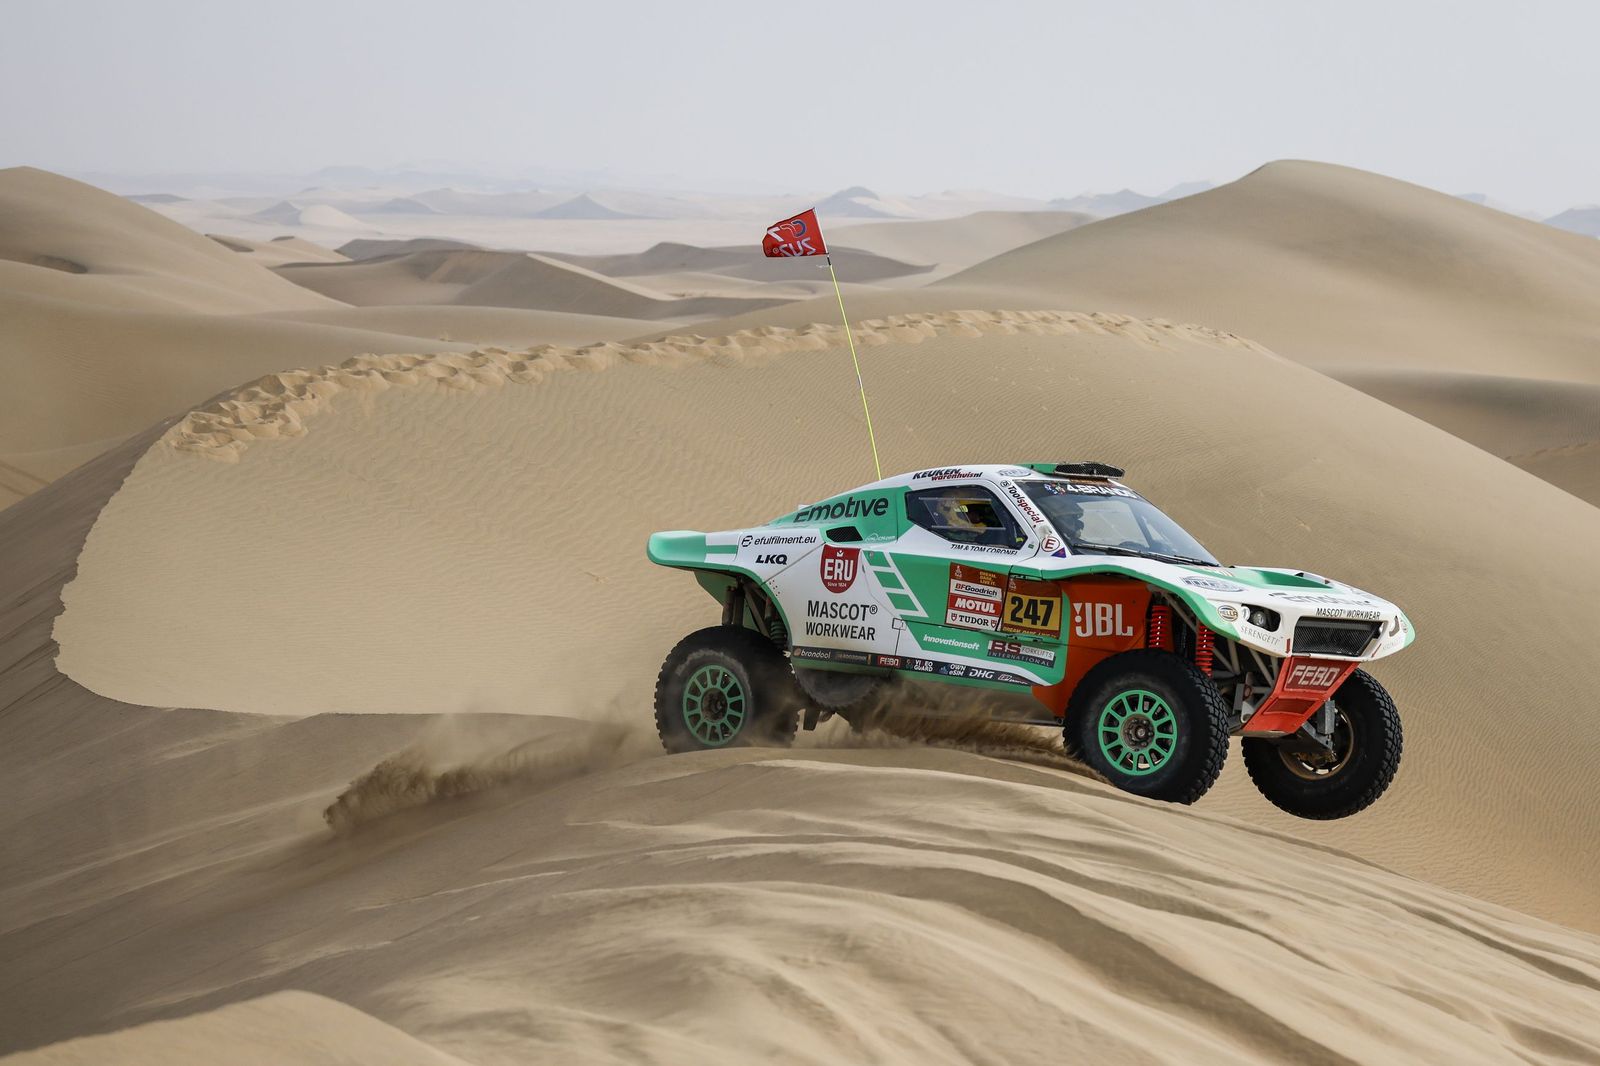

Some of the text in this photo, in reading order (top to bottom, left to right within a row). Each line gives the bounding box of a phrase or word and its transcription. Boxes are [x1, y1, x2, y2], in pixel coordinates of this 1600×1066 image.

[913, 468, 962, 480] KEUKEN
[793, 496, 889, 523] Emotive
[1008, 485, 1044, 524] Toolspecial
[754, 535, 817, 546] efulfilment.eu
[755, 553, 788, 565] LKQ
[824, 558, 854, 582] ERU
[955, 583, 998, 597] BFGoodrich
[955, 598, 996, 613] MOTUL
[1010, 596, 1054, 627] 247
[958, 614, 989, 627] TUDOR
[1073, 602, 1134, 638] JBL
[1346, 609, 1381, 620] WORKWEAR
[806, 622, 876, 641] WORKWEAR
[988, 651, 1051, 667] INTERNATIONAL
[1021, 646, 1054, 659] FORKLIFTS
[914, 664, 934, 672] GUARD
[950, 663, 966, 671] OWN
[968, 668, 995, 679] DHG
[1287, 664, 1340, 687] FEBO
